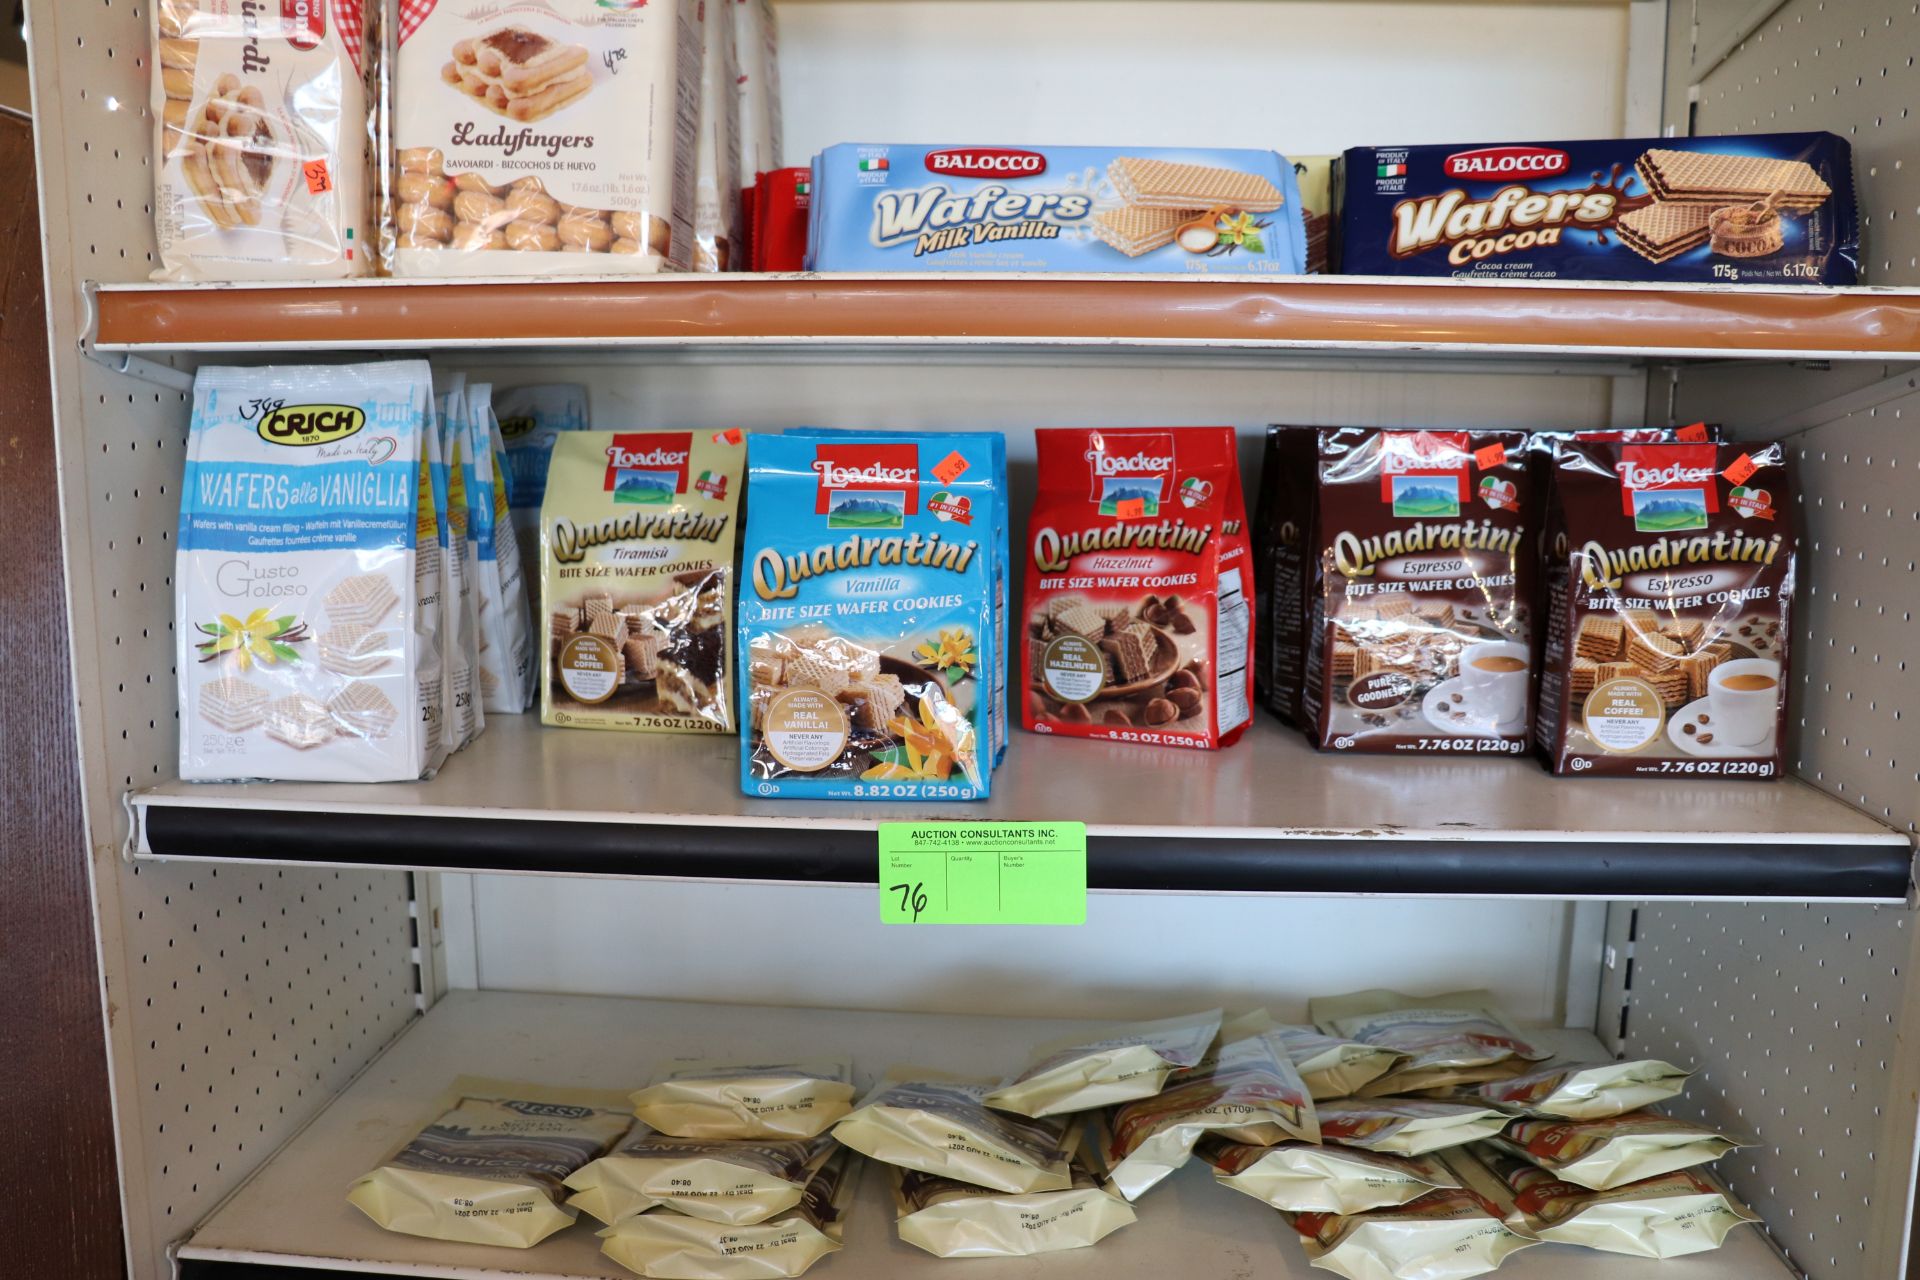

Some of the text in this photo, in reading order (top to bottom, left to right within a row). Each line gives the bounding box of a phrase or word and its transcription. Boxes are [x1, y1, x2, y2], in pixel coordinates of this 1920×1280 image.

[450, 121, 595, 157] Ladyfingers
[933, 154, 1040, 171] BALOCCO
[1376, 151, 1409, 159] PRODUCT
[446, 160, 596, 171] SAVOIARDI BIZCOCHOS DE HUEVO
[1453, 154, 1563, 173] BALOCCO
[878, 185, 1092, 241] Wafers
[1396, 187, 1616, 253] Wafers
[914, 221, 1061, 257] Milk Vanilla
[1185, 261, 1280, 273] 175g 6.17oz
[1475, 262, 1502, 270] Cocoa
[1712, 263, 1819, 281] 175g 6.17oz
[1452, 270, 1498, 279] Gaufrettes
[1500, 270, 1527, 278] crème
[268, 410, 355, 437] CRICH
[301, 434, 320, 442] 1870
[316, 446, 341, 459] Made
[355, 444, 378, 459] Italy
[605, 447, 689, 468] Loacker
[1084, 451, 1173, 477] Loacker
[811, 460, 917, 488] Loacker
[1615, 461, 1715, 488] Loacker
[201, 472, 409, 510] WAFERS alla VANIGLIA
[929, 501, 939, 509] #1
[949, 505, 967, 516] ITALY
[1748, 500, 1768, 511] ITALY
[193, 519, 342, 534] Wafers with vanilla cream filling Waffeln mit
[248, 533, 357, 546] Gaufrettes fourrées crème vanille
[551, 511, 729, 565] Quadratini
[612, 547, 669, 560] Tiramisù
[1033, 518, 1213, 574] Quadratini
[1334, 519, 1525, 578] Quadratini
[752, 533, 979, 601] Quadratini
[1093, 556, 1155, 570] Hazelnut
[1580, 529, 1782, 590] Quadratini
[559, 560, 713, 579] BITE SIZE WAFER COOKIES
[1402, 560, 1462, 575] Espresso
[845, 578, 901, 594] Vanilla
[1039, 573, 1197, 590] BITE SIZE WAFER COOKIES
[1344, 575, 1516, 596] BITE SIZE WAFER COOKIES
[1647, 574, 1714, 591] Espresso
[1588, 586, 1771, 610] BITE SIZE WAFER COOKIES
[762, 595, 963, 621] BITE SIZE WAFER COOKIES
[578, 653, 598, 661] REAL
[1062, 653, 1083, 662] REAL
[1367, 675, 1392, 690] PURE
[793, 711, 819, 720] REAL
[1603, 707, 1644, 715] COFFEE!
[634, 717, 662, 727] 7.76
[663, 718, 682, 729] OZ
[684, 719, 714, 730] (220
[783, 721, 829, 729] VANILLA!
[1109, 730, 1139, 742] 8.82
[1140, 732, 1162, 744] OZ
[1163, 733, 1194, 747] (250
[1418, 739, 1525, 753] 7.76 OZ (220 g)
[1660, 762, 1695, 773] 7.76
[1697, 762, 1720, 773] OZ
[1722, 762, 1759, 775] (220
[1759, 762, 1775, 776] g)
[854, 786, 890, 797] 8.82
[893, 786, 918, 797] OZ
[921, 785, 958, 798] (250
[960, 787, 977, 798] g)
[911, 829, 1059, 839] AUCTION CONSULTANTS INC.
[965, 838, 1056, 846] www.auctionconsultants.net
[889, 882, 928, 924] 76
[1222, 1104, 1254, 1116] (170g)
[472, 1209, 489, 1217] AUG
